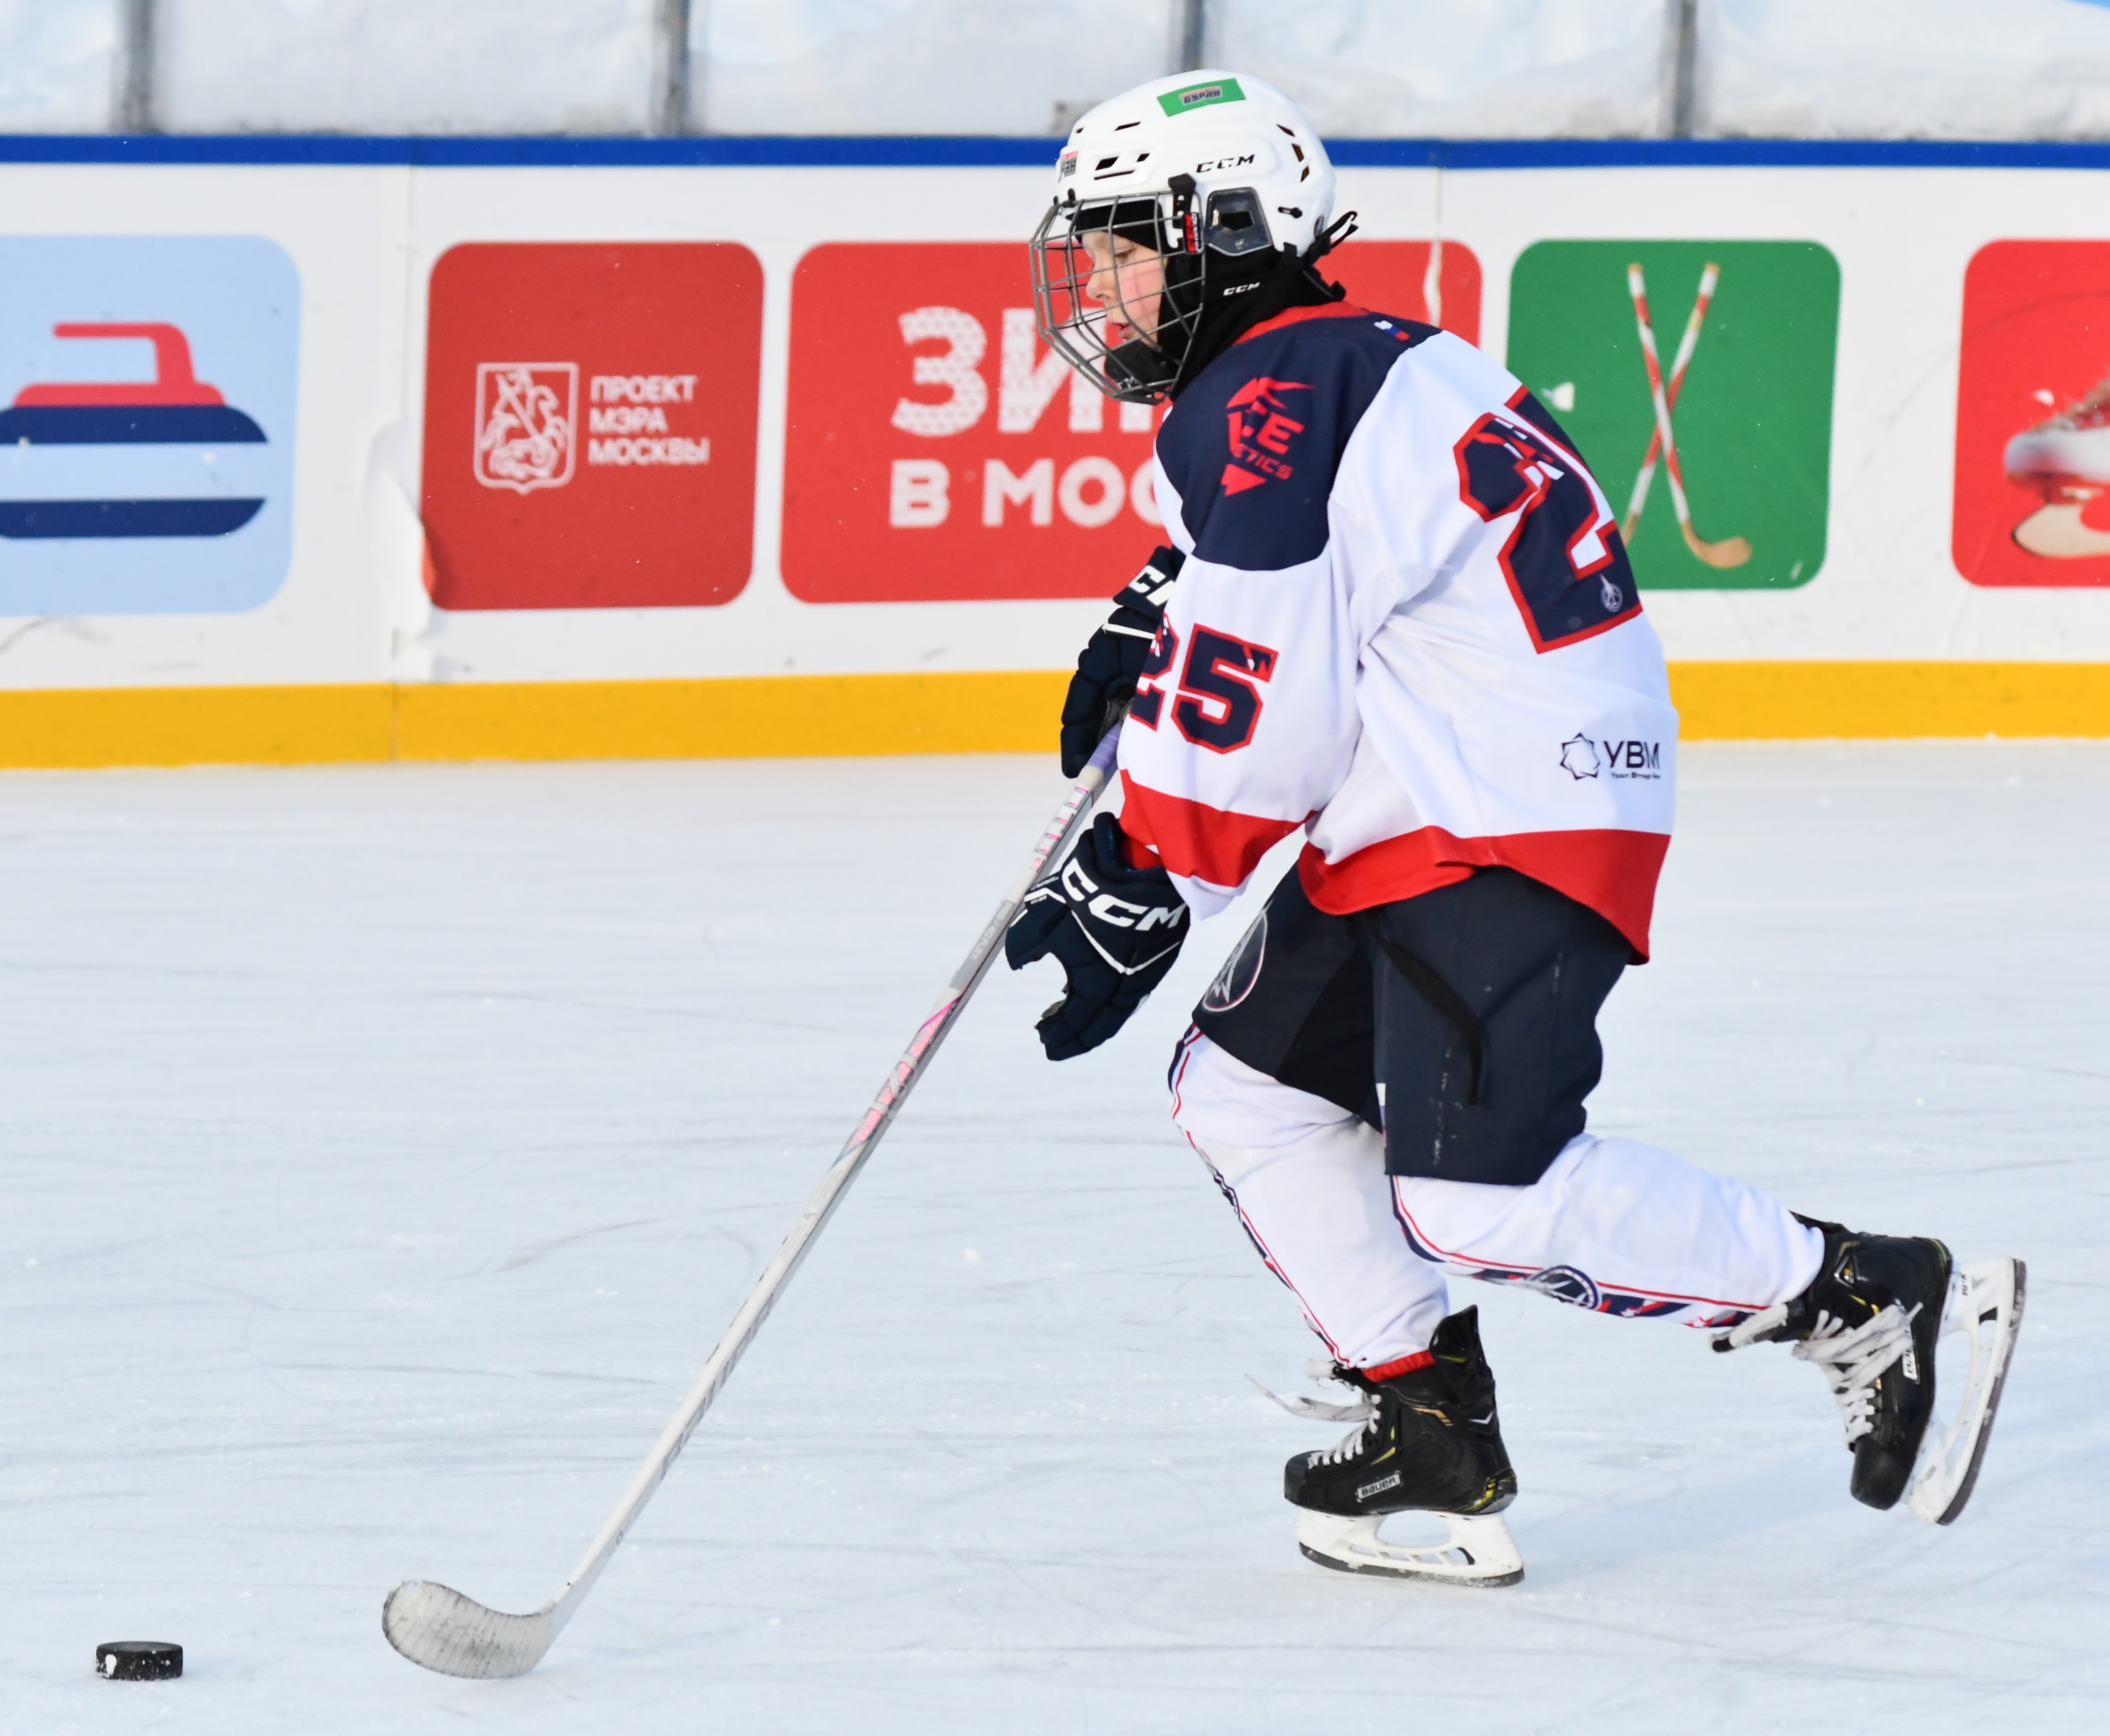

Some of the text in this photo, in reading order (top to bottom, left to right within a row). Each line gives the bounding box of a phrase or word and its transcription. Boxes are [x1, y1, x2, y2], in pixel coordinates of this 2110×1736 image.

[1196, 154, 1255, 173] CCM
[1223, 282, 1261, 296] CCM
[891, 305, 1153, 437] ЗИ
[590, 375, 698, 402] ПРОЕКТ
[589, 407, 668, 433] МЭРА
[587, 438, 710, 464] МОСКВЫ
[890, 456, 1169, 528] В МОС
[1061, 858, 1187, 931] CCM
